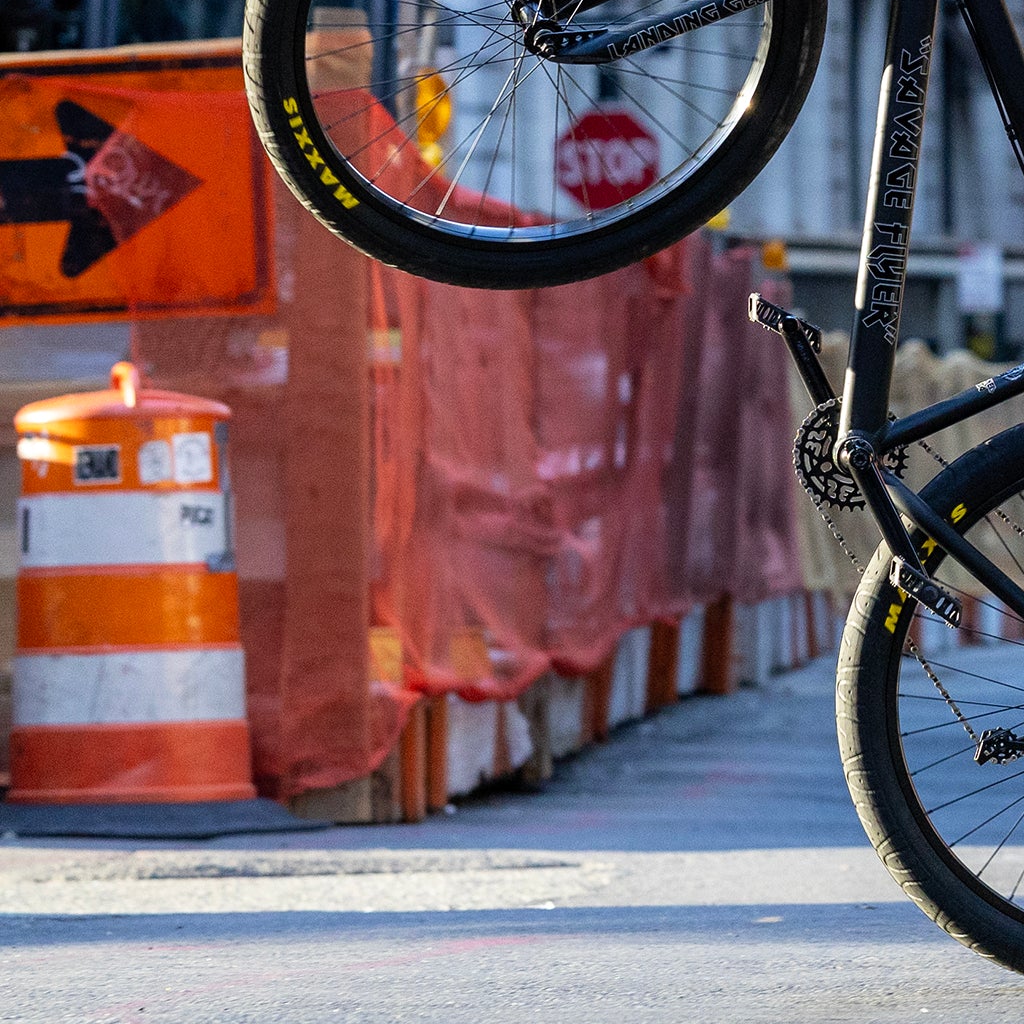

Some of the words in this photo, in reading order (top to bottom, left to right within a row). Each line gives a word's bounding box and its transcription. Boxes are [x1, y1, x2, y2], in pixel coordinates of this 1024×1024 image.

[607, 2, 720, 60] LANDING
[283, 97, 360, 209] MAXXIS
[559, 138, 657, 186] STOP
